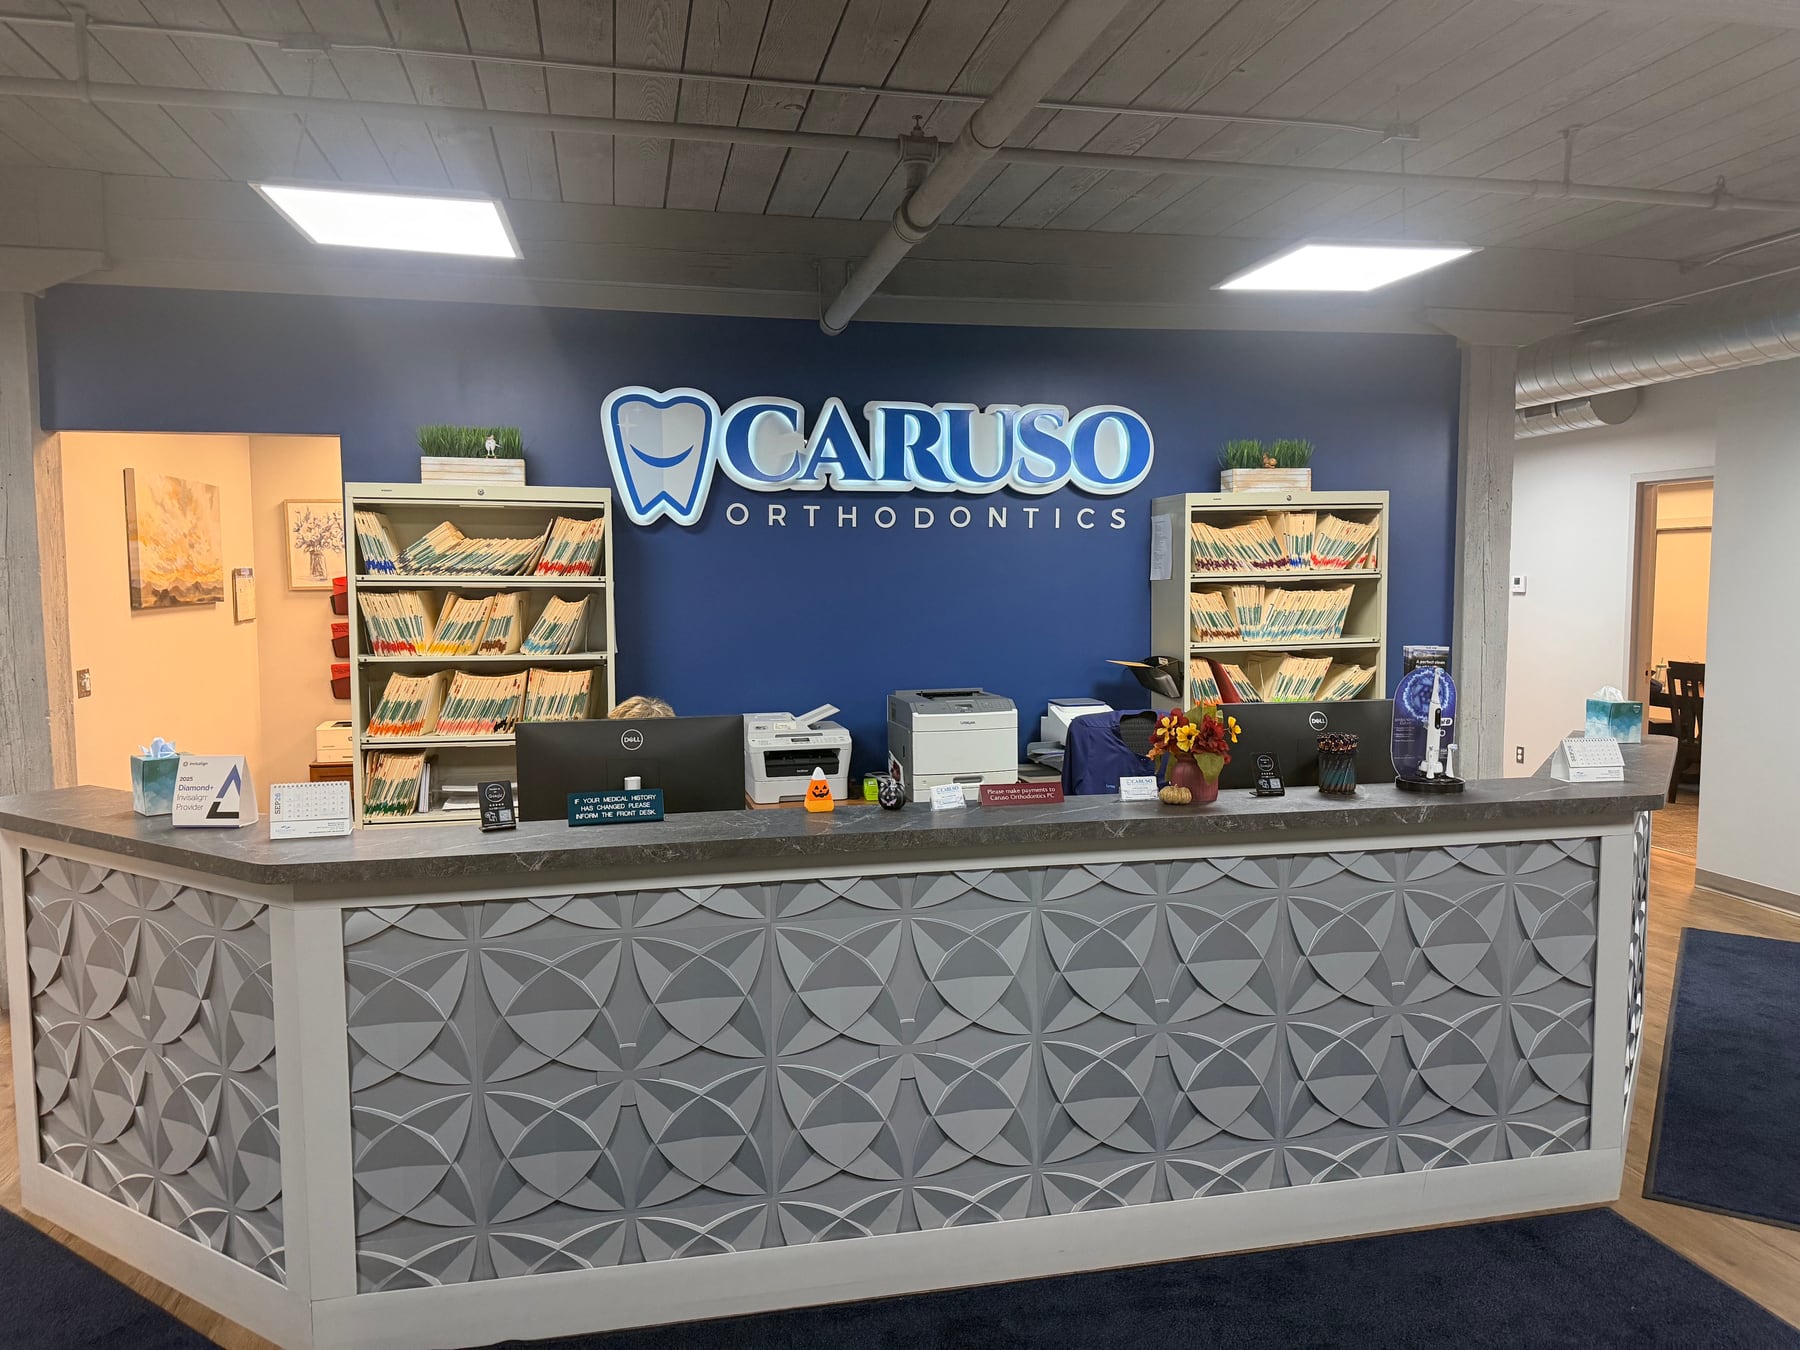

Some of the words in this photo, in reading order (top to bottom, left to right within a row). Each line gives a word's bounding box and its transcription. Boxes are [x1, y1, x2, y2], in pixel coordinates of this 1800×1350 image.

[723, 402, 1151, 486] CARUSO
[726, 502, 1127, 529] ORTHODONTICS
[602, 795, 629, 803] MEDICAL
[1010, 792, 1046, 800] Orthodontics
[175, 803, 204, 811] Provider
[596, 803, 626, 811] CHANGED
[628, 801, 651, 809] PLEASE
[575, 812, 599, 820] INFORM
